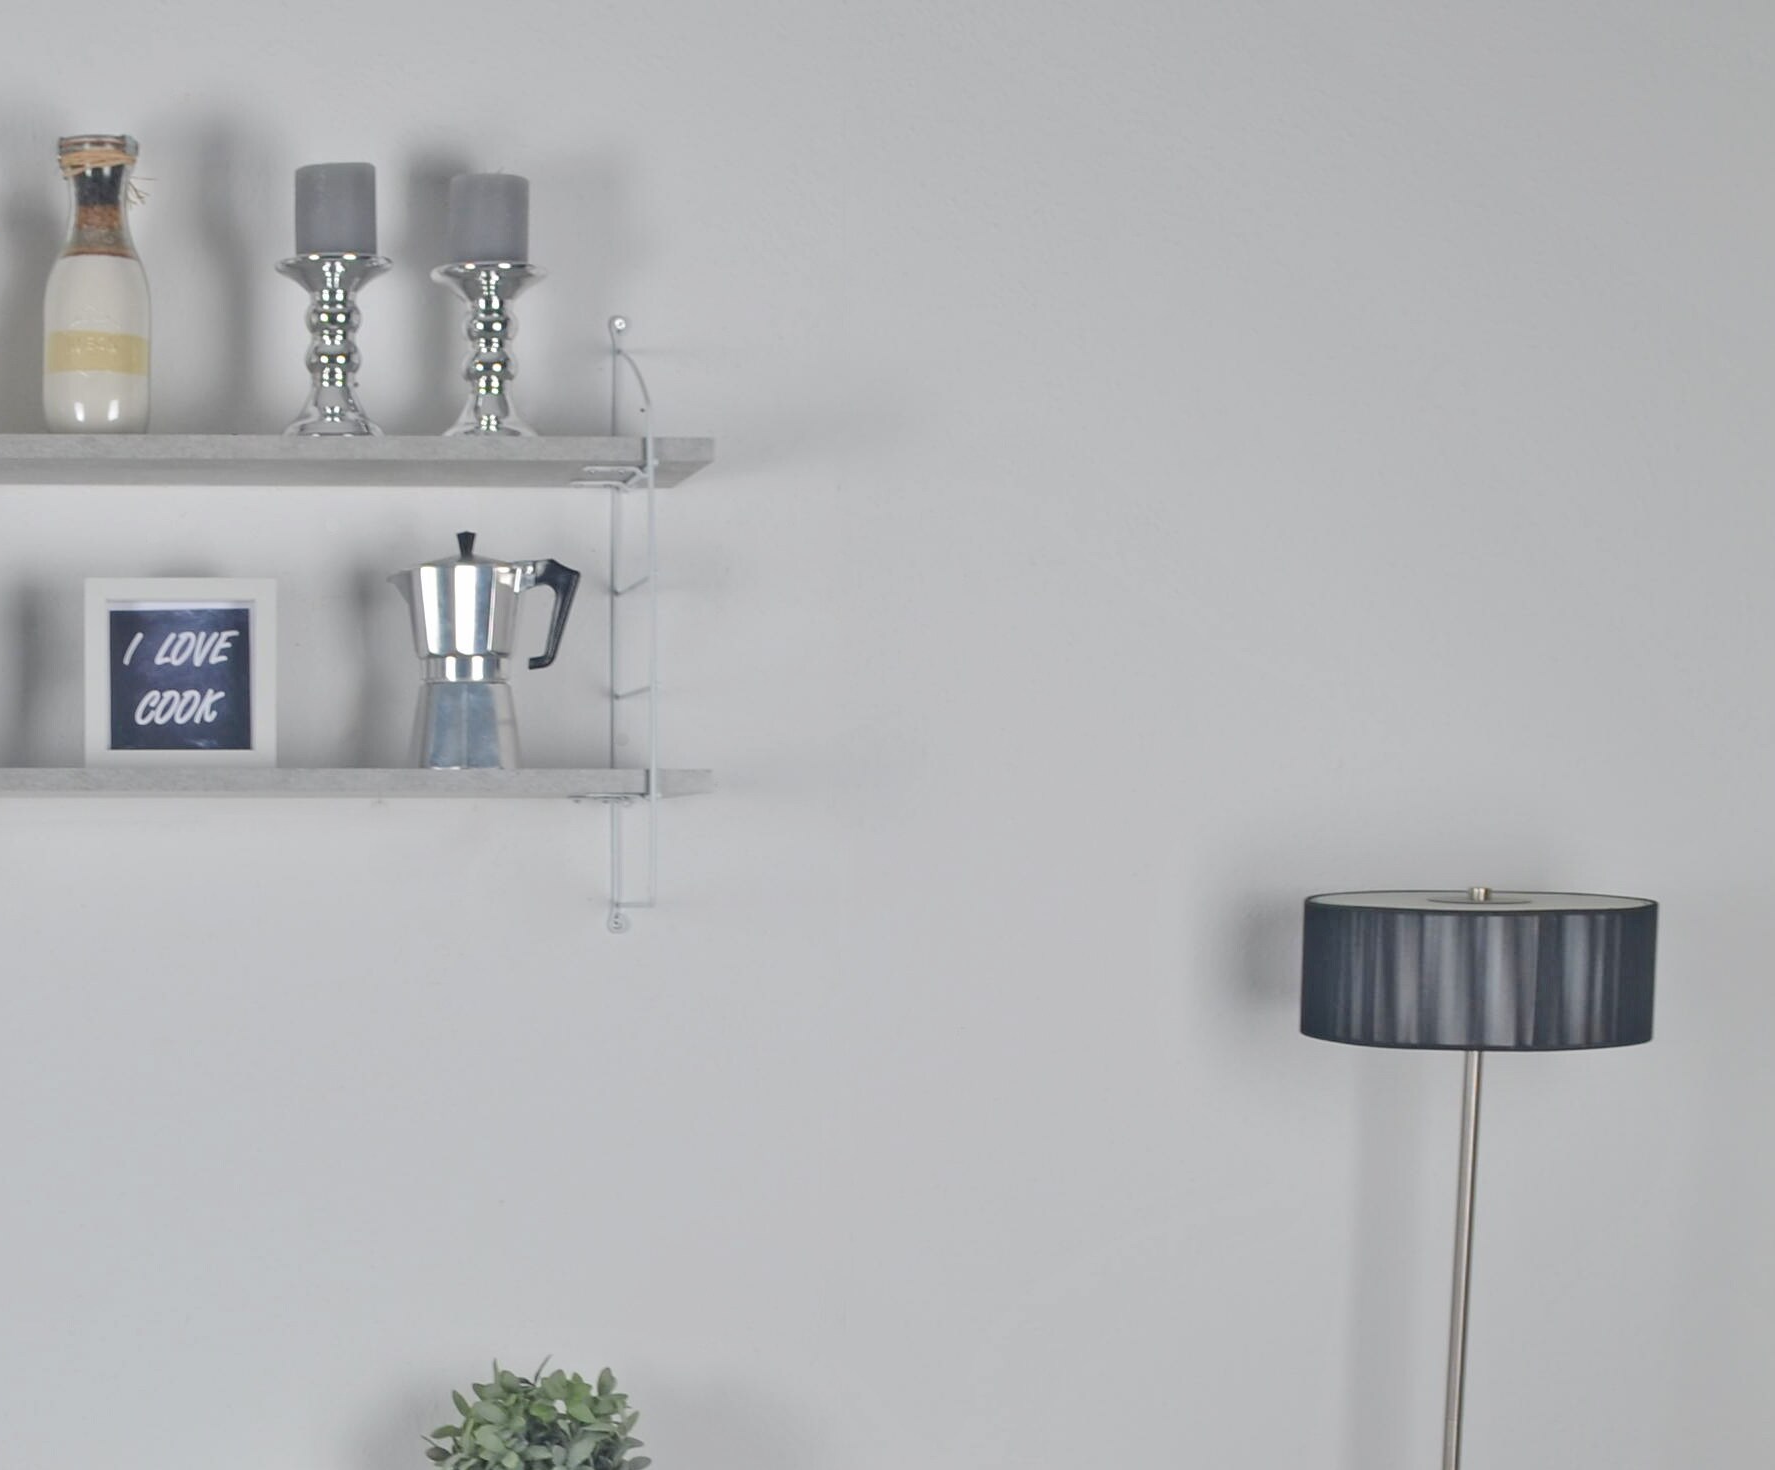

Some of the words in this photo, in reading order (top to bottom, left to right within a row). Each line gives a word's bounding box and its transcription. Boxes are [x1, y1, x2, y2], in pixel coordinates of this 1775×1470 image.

[123, 632, 144, 666] I
[154, 630, 240, 667] LOVE
[134, 688, 226, 726] COOK
